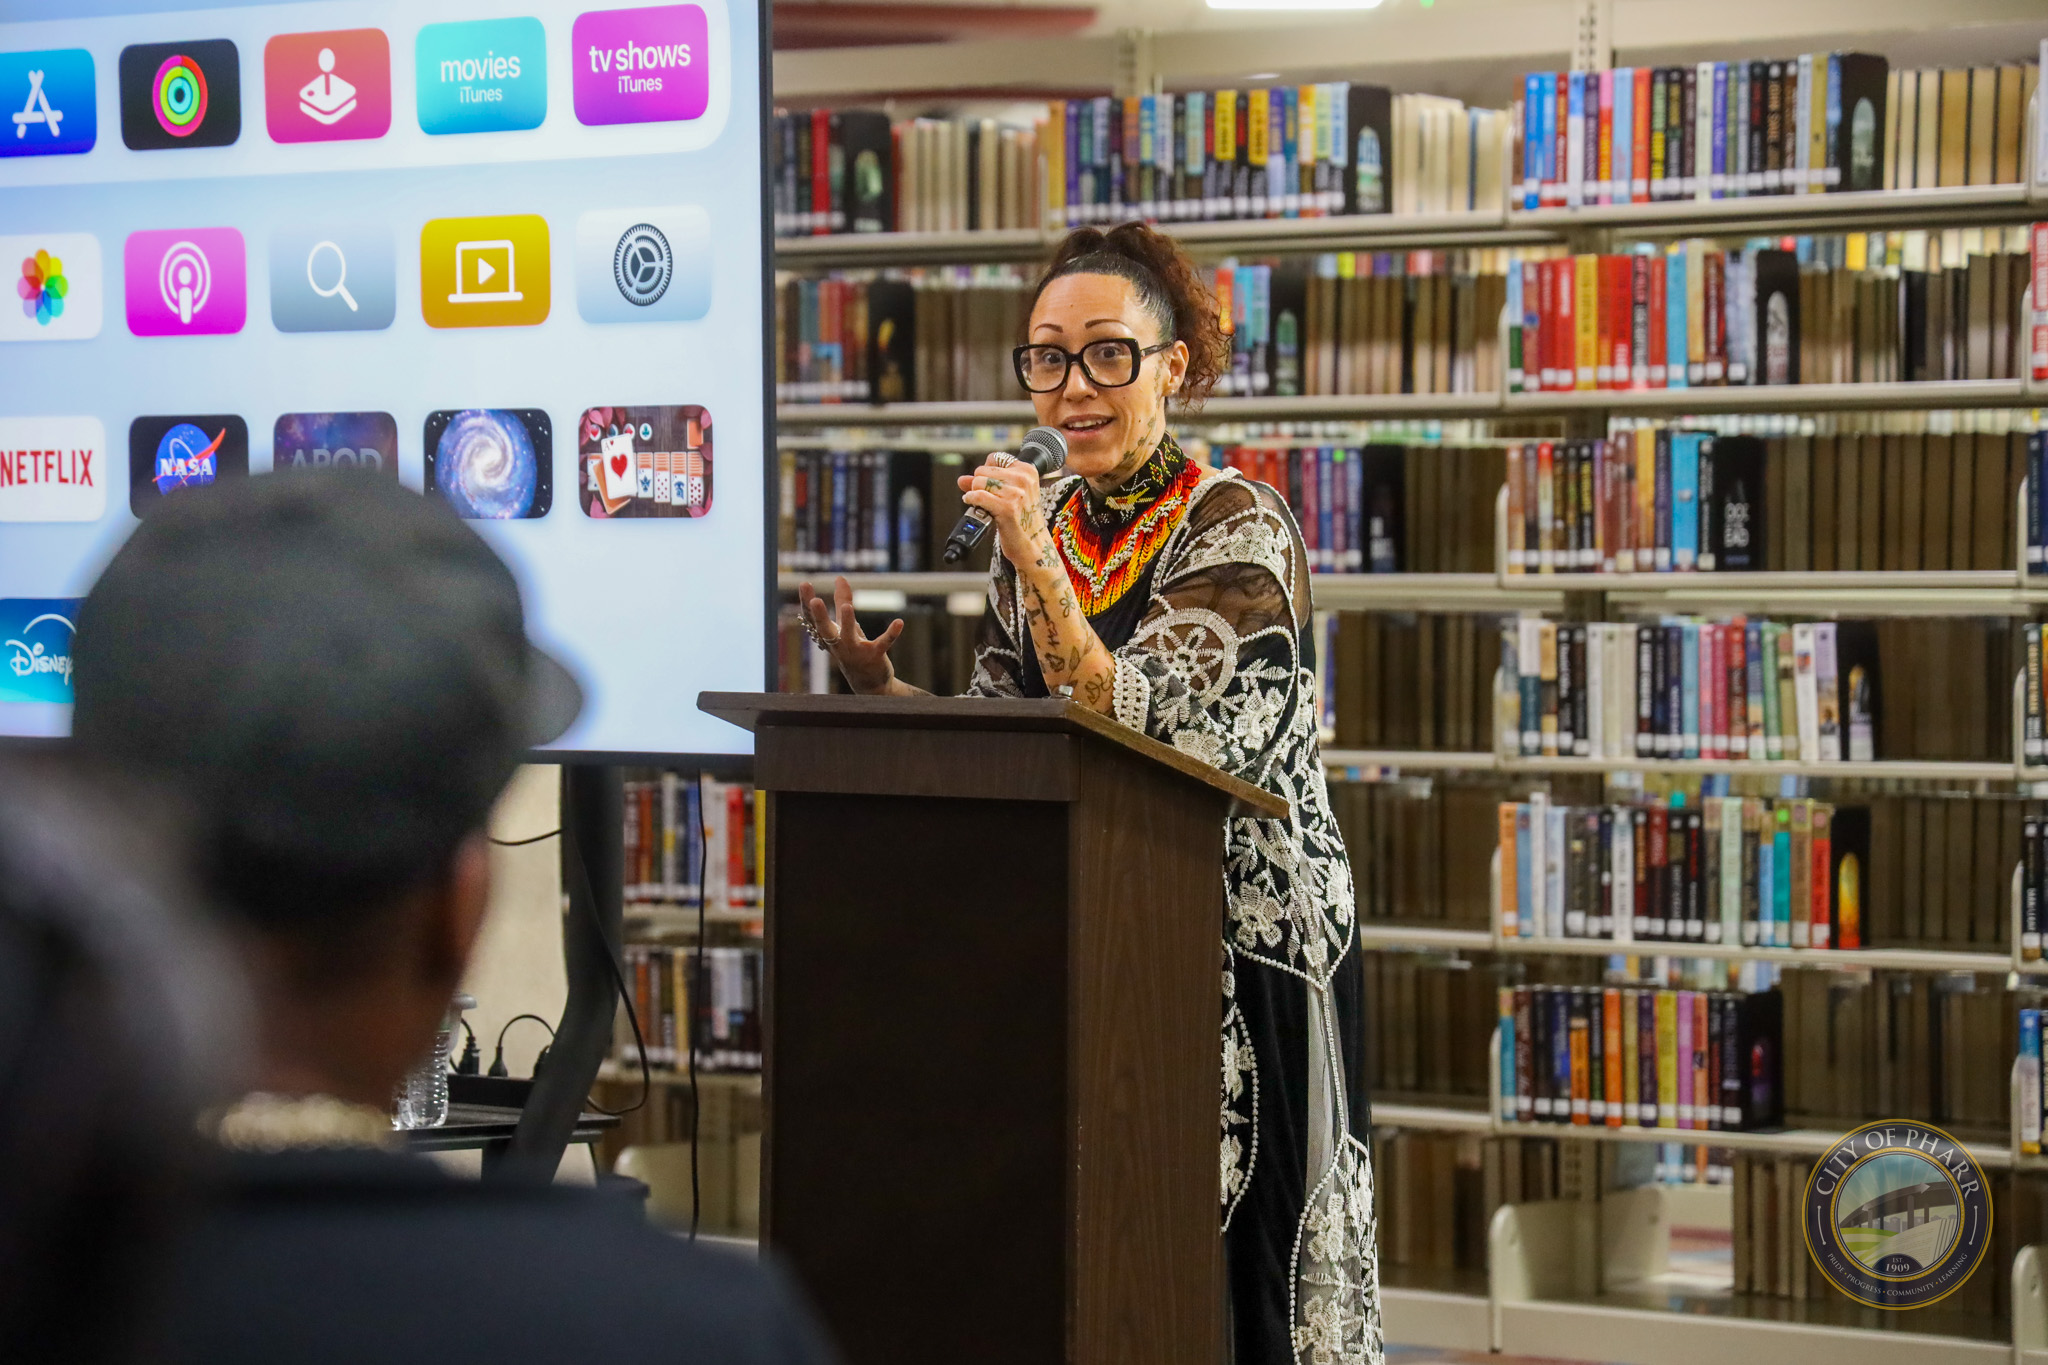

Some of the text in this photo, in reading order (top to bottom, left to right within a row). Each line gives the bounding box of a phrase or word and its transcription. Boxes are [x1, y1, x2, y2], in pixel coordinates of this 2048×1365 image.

[440, 50, 521, 83] movies
[589, 40, 692, 73] tv shows
[459, 86, 503, 104] iTunes
[618, 76, 663, 94] iTunes
[0, 449, 94, 488] NETFLIX
[160, 458, 214, 477] NASA
